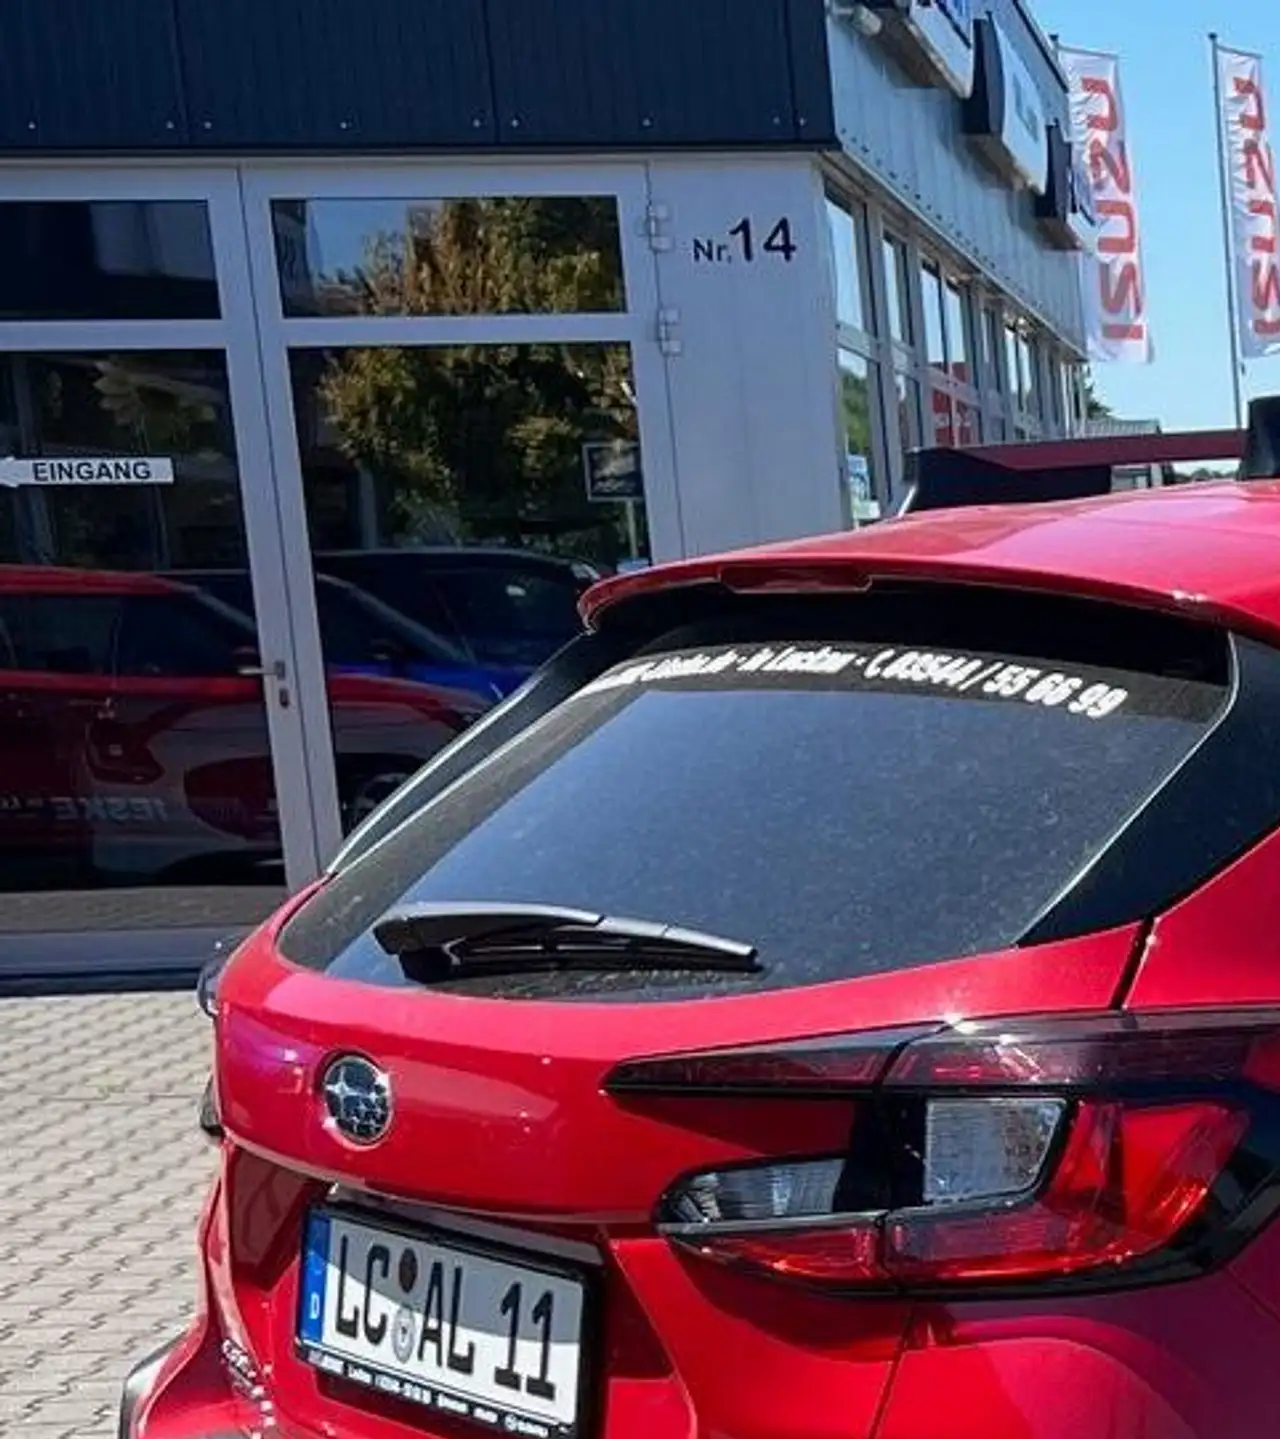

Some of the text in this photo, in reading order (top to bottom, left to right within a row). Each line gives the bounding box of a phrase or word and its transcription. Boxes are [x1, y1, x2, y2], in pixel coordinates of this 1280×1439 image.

[1082, 76, 1144, 340] ISUZU
[32, 461, 153, 482] EINGANG
[335, 1234, 556, 1402] LC AL 11
